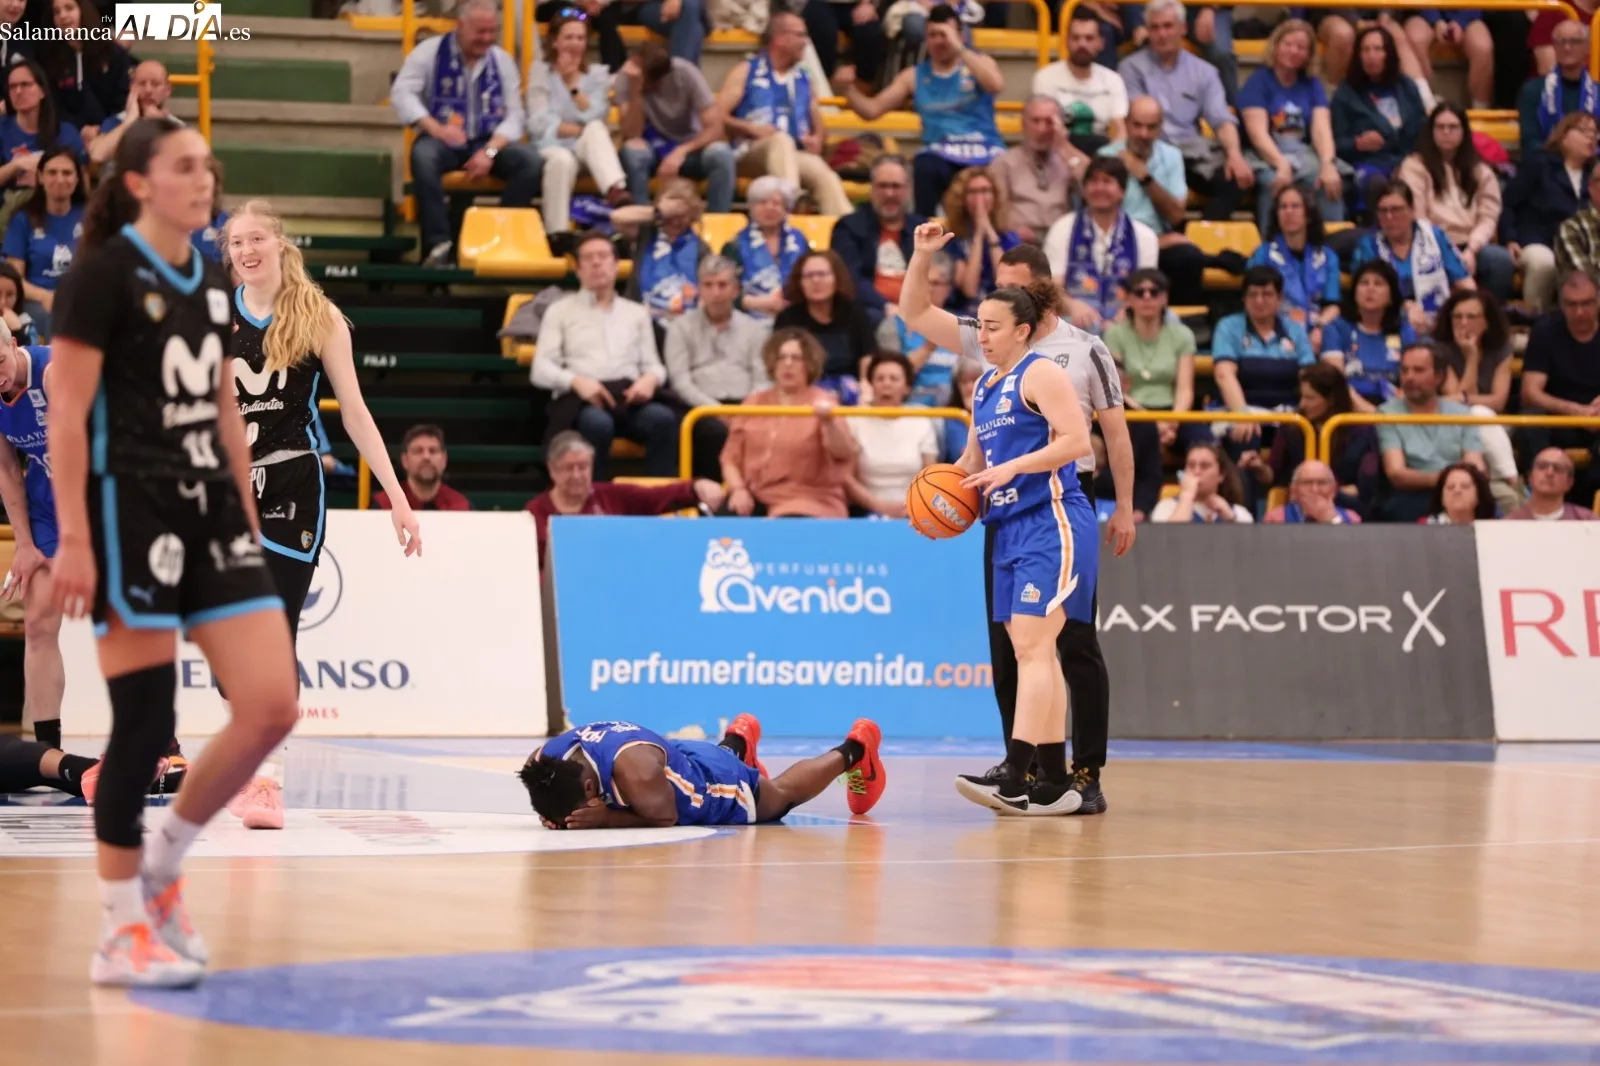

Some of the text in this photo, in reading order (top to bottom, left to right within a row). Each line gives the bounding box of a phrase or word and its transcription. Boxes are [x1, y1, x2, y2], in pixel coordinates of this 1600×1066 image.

[325, 265, 348, 277] FILA
[363, 354, 387, 367] FILA
[990, 487, 1019, 507] sa
[717, 575, 892, 615] avenida
[1096, 604, 1176, 632] AX
[1190, 605, 1393, 632] FACTOR
